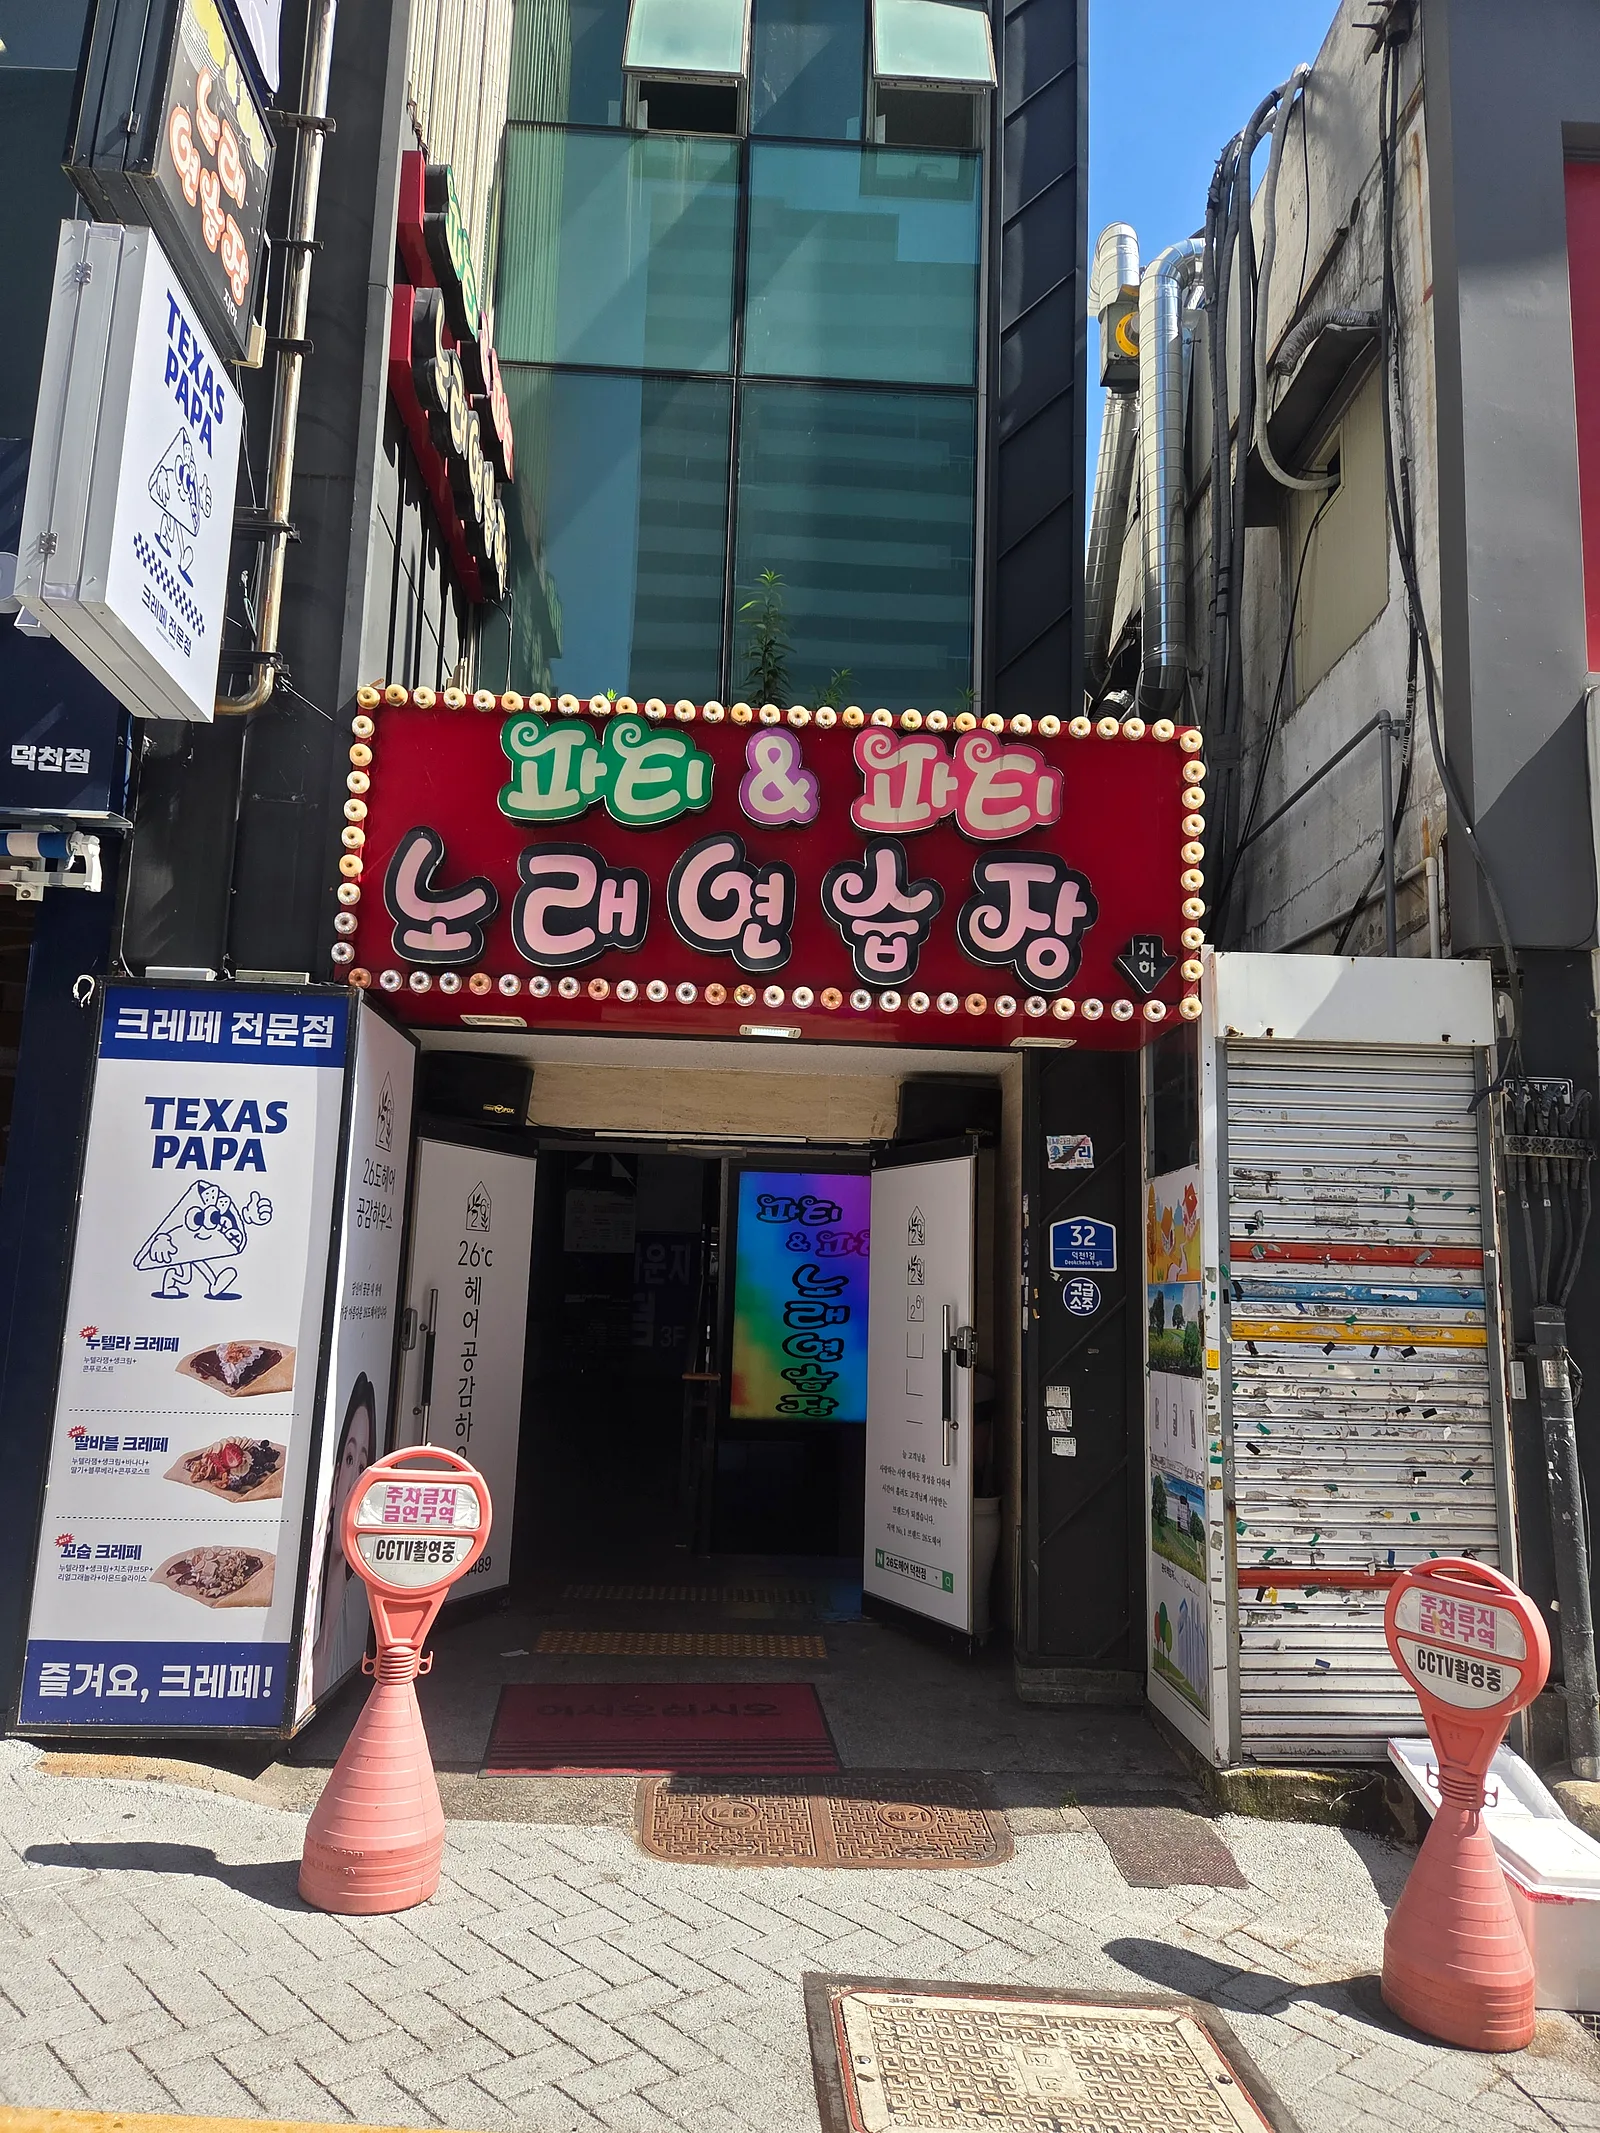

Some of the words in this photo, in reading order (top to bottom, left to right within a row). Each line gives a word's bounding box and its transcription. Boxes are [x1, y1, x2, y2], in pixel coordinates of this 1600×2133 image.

[196, 66, 246, 209] 노래
[169, 106, 250, 306] 연습장
[166, 288, 225, 425] TEXAS
[164, 344, 213, 459] PAPA
[141, 583, 168, 629] 크레페
[168, 615, 192, 658] 전문점
[11, 744, 91, 774] 덕천점
[500, 714, 711, 822] 파티
[741, 728, 818, 822] &
[854, 729, 1062, 839] 파티
[1138, 942, 1157, 978] 지하
[114, 1007, 222, 1044] 크레페
[230, 1011, 335, 1049] 전문점
[144, 1096, 289, 1134] TEXAS
[151, 1135, 268, 1172] PAPA
[362, 1157, 396, 1195] 26도헤어
[356, 1197, 393, 1230] 공감하우스
[757, 1193, 843, 1226] 파티
[786, 1231, 812, 1252] &
[1070, 1225, 1096, 1246] 32
[1071, 1251, 1095, 1260] 덕천1길
[1069, 1296, 1094, 1310] 소주
[1070, 1282, 1094, 1297] 고급
[86, 1335, 132, 1351] 누텔라
[134, 1336, 180, 1352] 크레페
[74, 1435, 119, 1451] 딸바블
[122, 1436, 169, 1452] 크레페
[386, 1486, 457, 1505] 주차금지
[384, 1504, 455, 1524] 금연구역
[95, 1544, 142, 1560] 크레페
[375, 1539, 456, 1563] CCTV촬영중
[465, 1555, 492, 1577] 489
[886, 1556, 909, 1574] 26도헤어
[910, 1563, 927, 1580] 덕천점
[1420, 1594, 1496, 1630] 주차금지
[1420, 1613, 1495, 1649] 금연구역
[38, 1662, 150, 1703] 즐겨요,
[158, 1664, 274, 1699] 크레페!
[1417, 1649, 1501, 1692] CCTV촬영중
